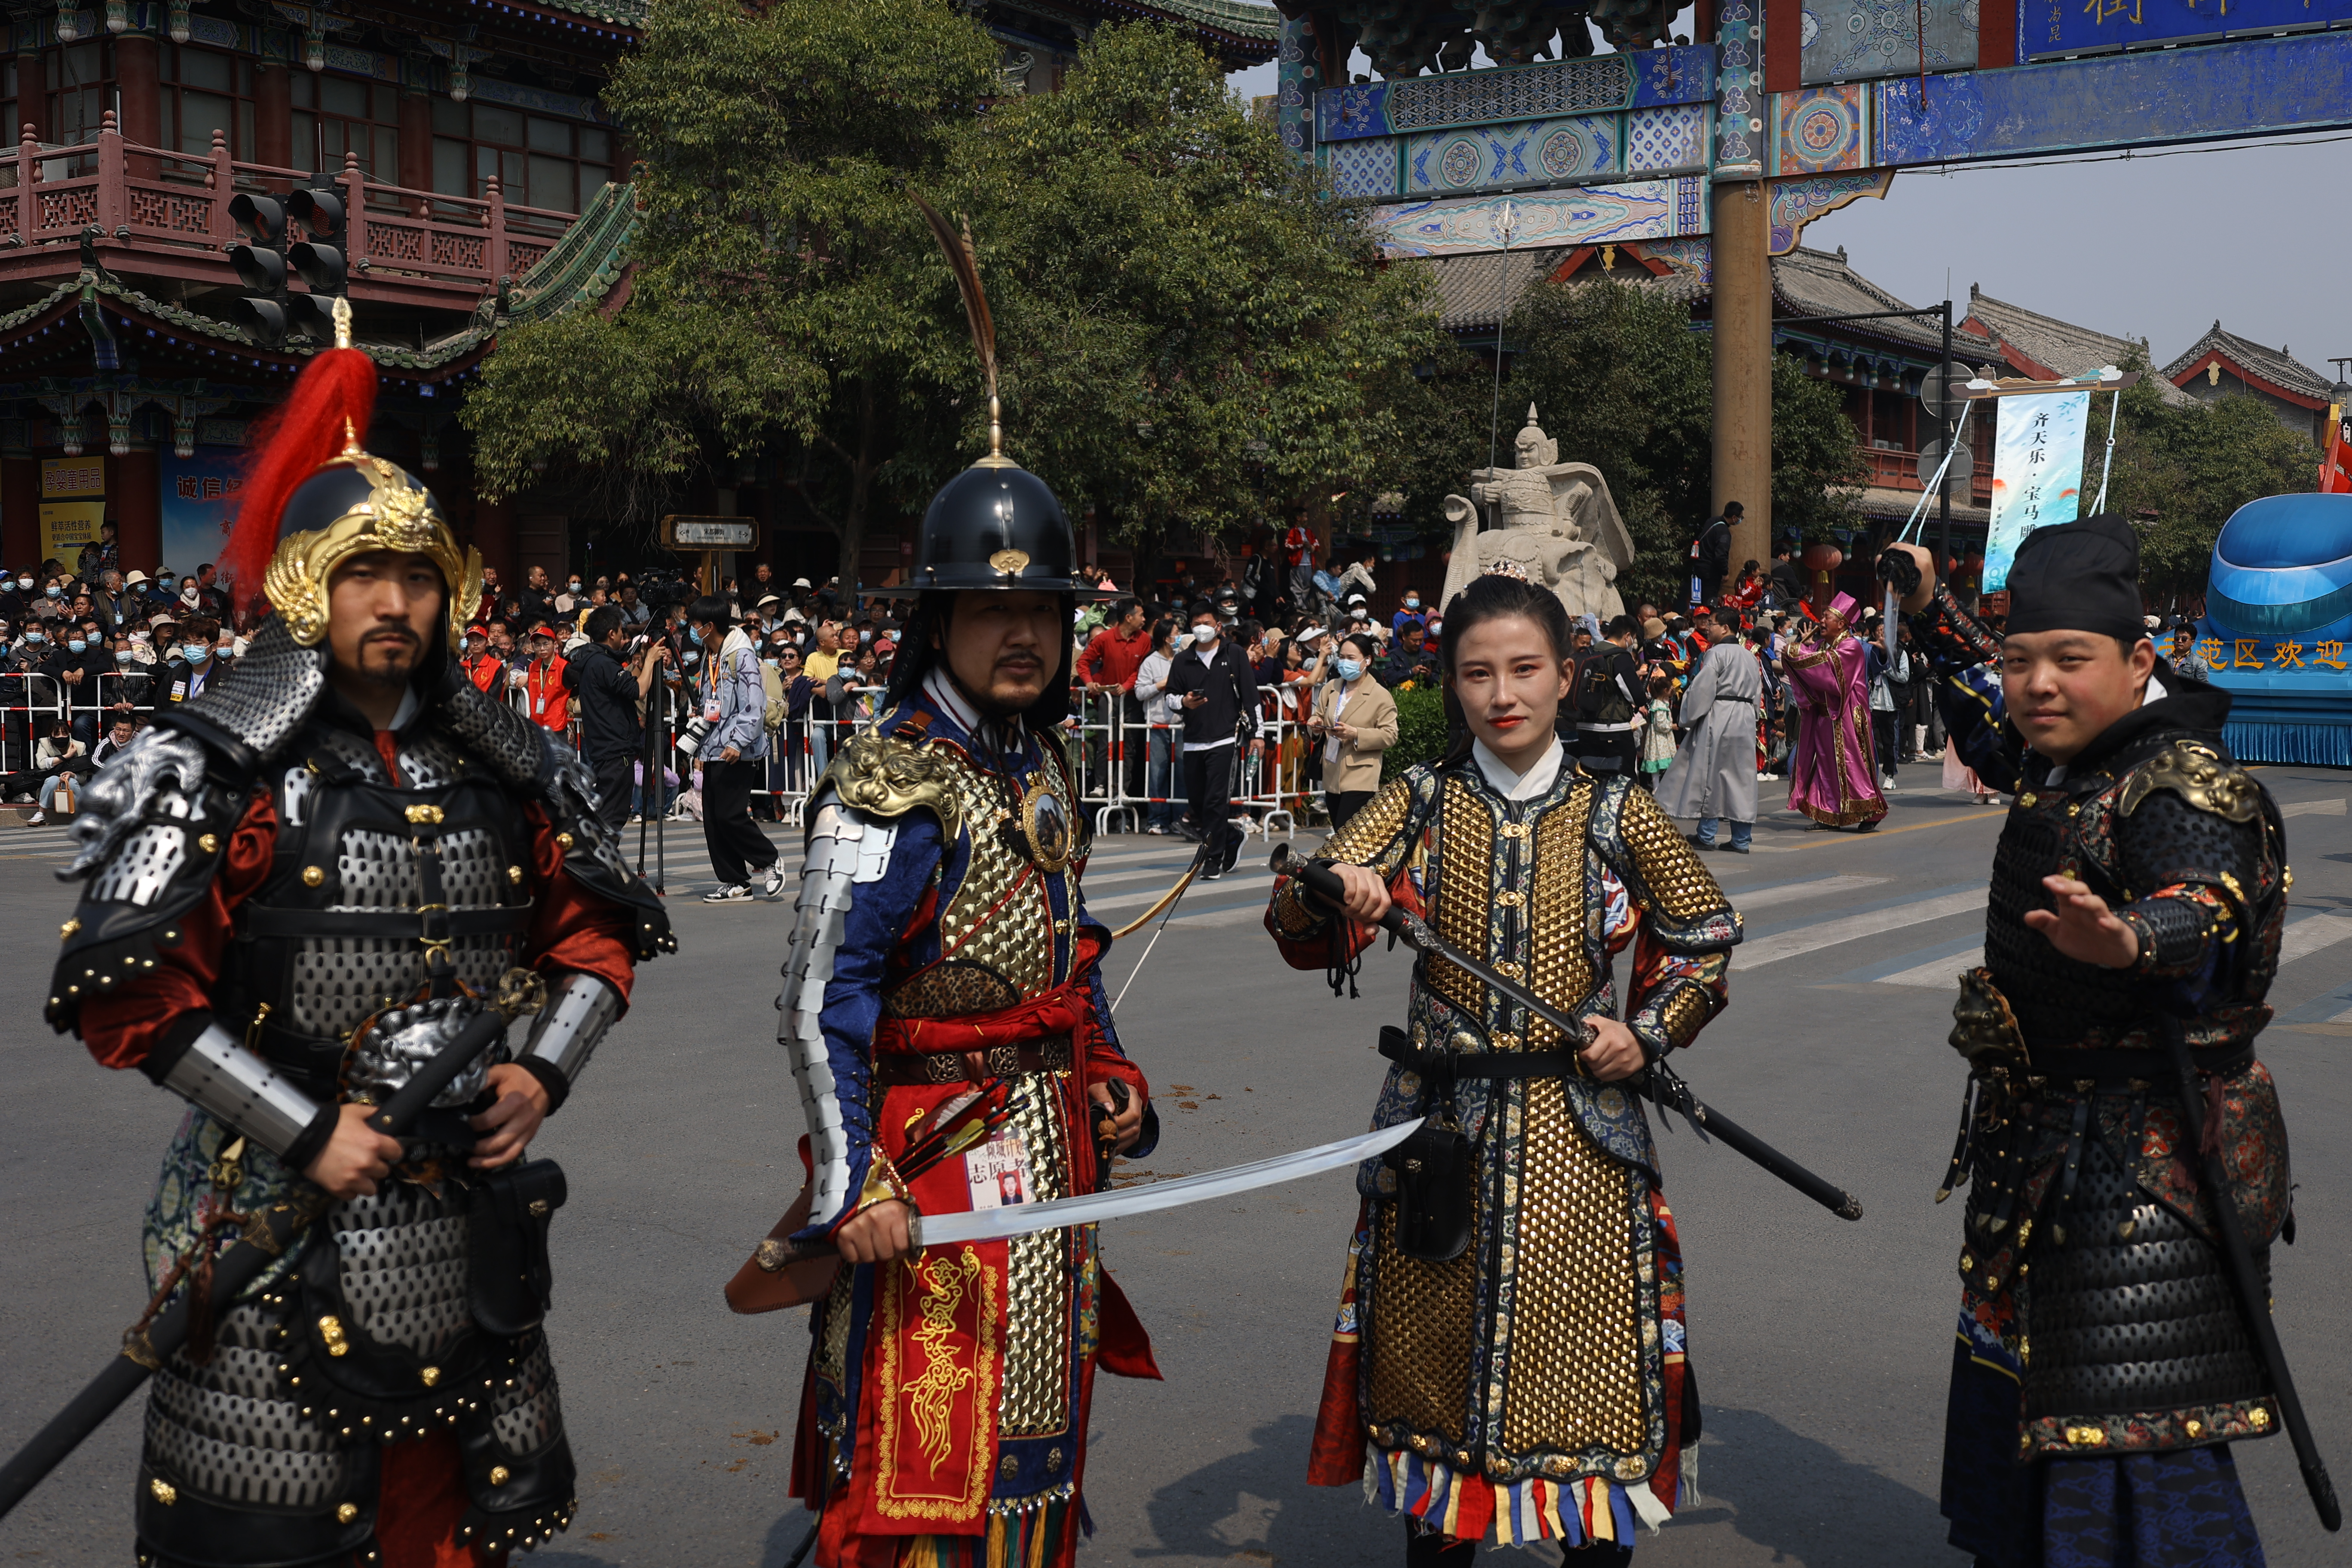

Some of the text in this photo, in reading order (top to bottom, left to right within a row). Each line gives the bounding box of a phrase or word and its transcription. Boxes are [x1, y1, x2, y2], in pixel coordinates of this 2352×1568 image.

[2045, 0, 2061, 43] 尚昆
[45, 468, 101, 491] 孕婴童用品
[51, 519, 91, 532] 鲜萃活性营养
[52, 533, 92, 541] 更适合中国宝宝体质
